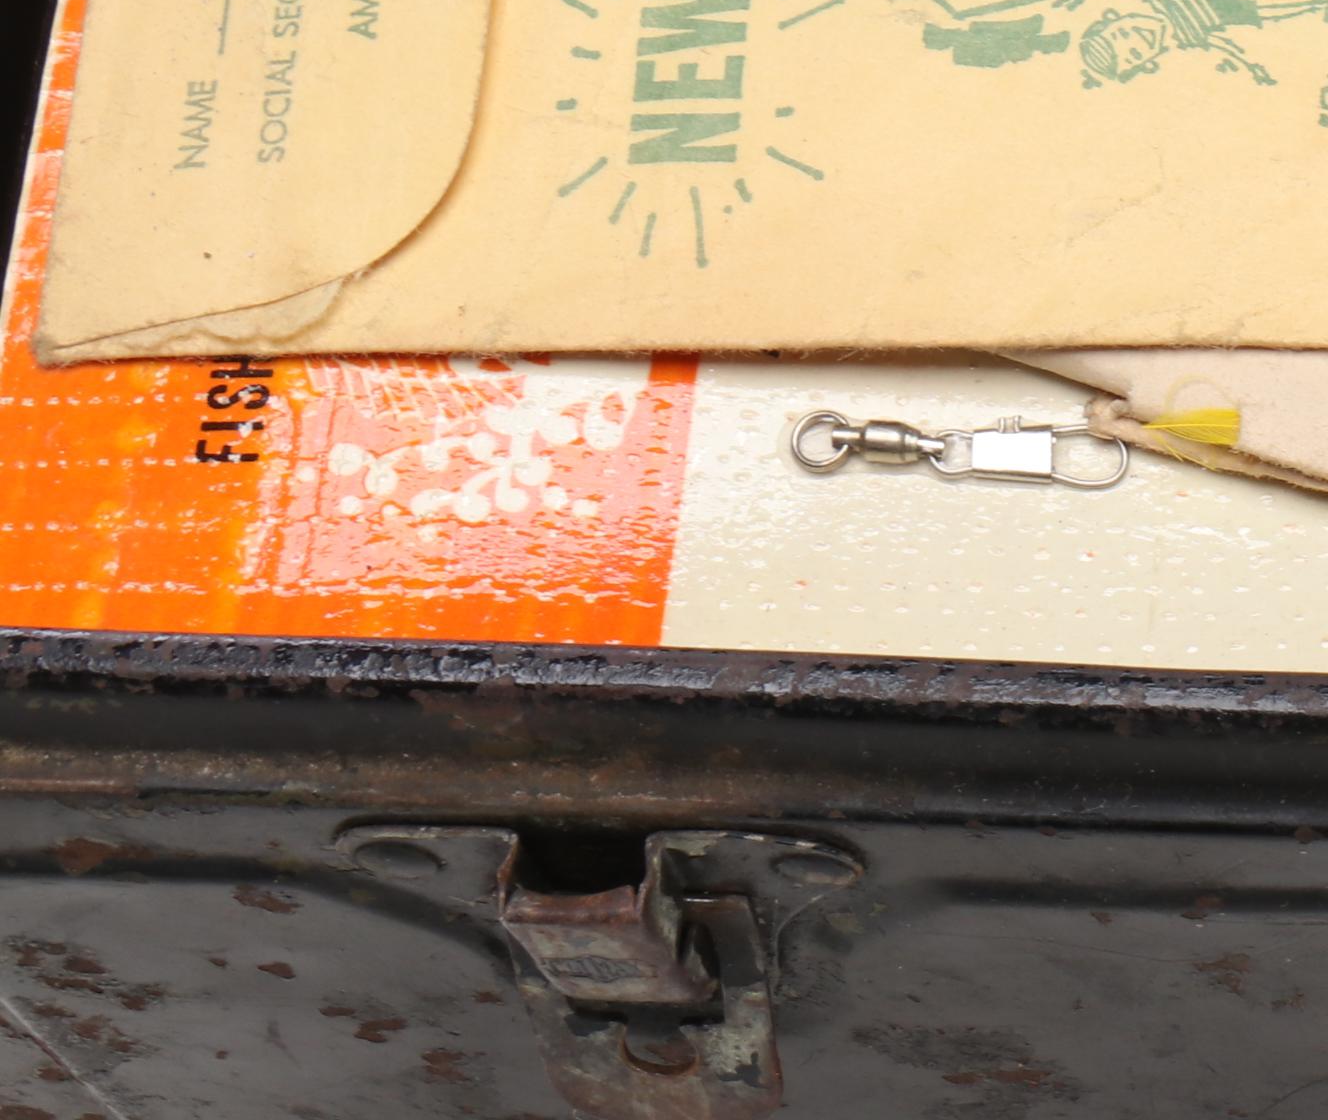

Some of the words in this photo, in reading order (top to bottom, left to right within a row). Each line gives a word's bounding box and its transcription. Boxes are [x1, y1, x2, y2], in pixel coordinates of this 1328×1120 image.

[173, 79, 218, 169] NAME
[257, 50, 298, 164] SOCIAL
[195, 355, 274, 462] FISH
